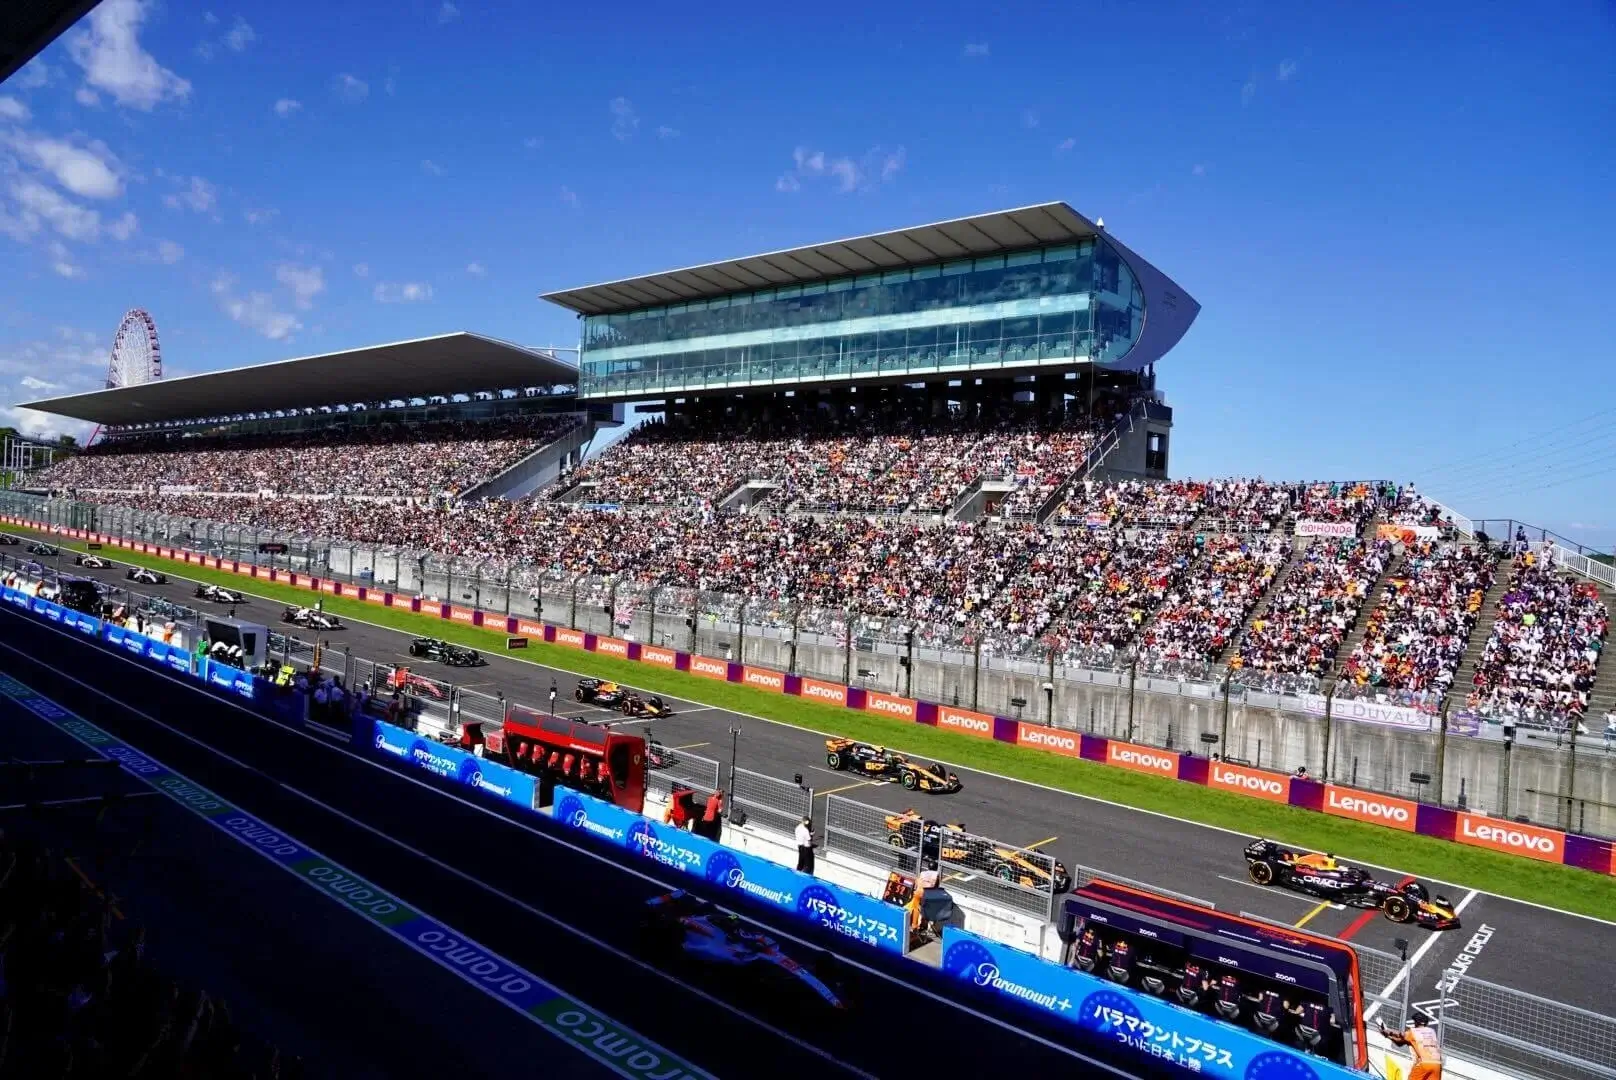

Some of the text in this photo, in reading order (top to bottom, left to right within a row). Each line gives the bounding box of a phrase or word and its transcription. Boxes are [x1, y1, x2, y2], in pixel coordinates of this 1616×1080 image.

[484, 614, 506, 628] Lenovo
[519, 622, 543, 636] Lenovo
[557, 629, 583, 645] Lenovo
[599, 638, 626, 654] Lenovo
[642, 648, 673, 664] Lenovo
[691, 659, 725, 675] Lenovo
[744, 669, 781, 687] Lenovo
[803, 682, 844, 701] Lenovo
[869, 695, 913, 716] Lenovo
[941, 708, 990, 731] Lenovo
[1020, 727, 1076, 750] Lenovo
[1111, 745, 1173, 770] Lenovo
[1213, 766, 1283, 794] Lenovo
[1329, 791, 1409, 821] Lenovo
[225, 817, 299, 856] aramco
[573, 809, 624, 840] Paramount+
[1463, 819, 1555, 852] Lenovo
[633, 832, 701, 866] パラマウントプラス
[308, 867, 398, 914] aramco
[727, 868, 793, 905] Paramount+
[1303, 874, 1349, 889] ORACLE
[806, 896, 899, 942] パラマウントプラス
[1090, 913, 1108, 924] zoom
[821, 918, 878, 948] ついに日本上陸
[1139, 928, 1158, 938] zoom
[417, 930, 531, 994] aramco
[1218, 956, 1239, 967] zoom
[974, 963, 1073, 1012] Paramount+
[1275, 972, 1297, 983] zoom
[556, 1010, 697, 1080] ramco
[1093, 1004, 1234, 1070] パラマウントプラス
[1116, 1032, 1202, 1073] ついに日本上陸
